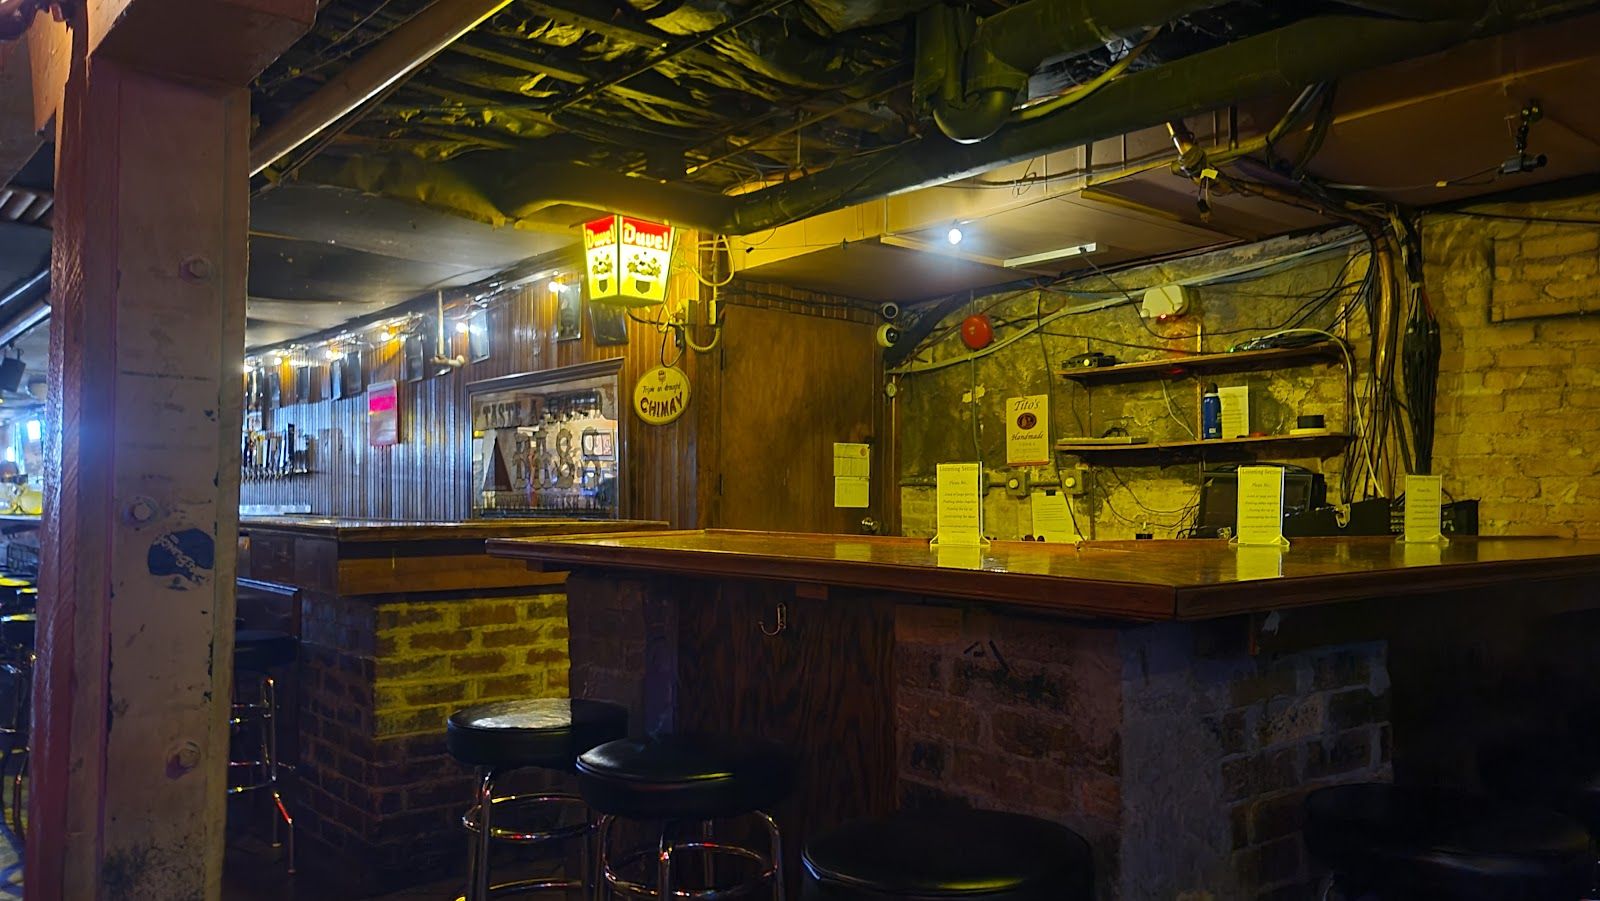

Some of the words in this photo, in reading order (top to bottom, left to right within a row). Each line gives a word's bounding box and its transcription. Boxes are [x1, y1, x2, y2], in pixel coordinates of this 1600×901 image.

[587, 224, 615, 249] Duvel
[623, 222, 669, 250] Duvel
[482, 400, 522, 428] TASTE
[640, 390, 683, 417] CHIMAY
[1014, 399, 1040, 411] Tito's
[1011, 430, 1044, 441] Handmade
